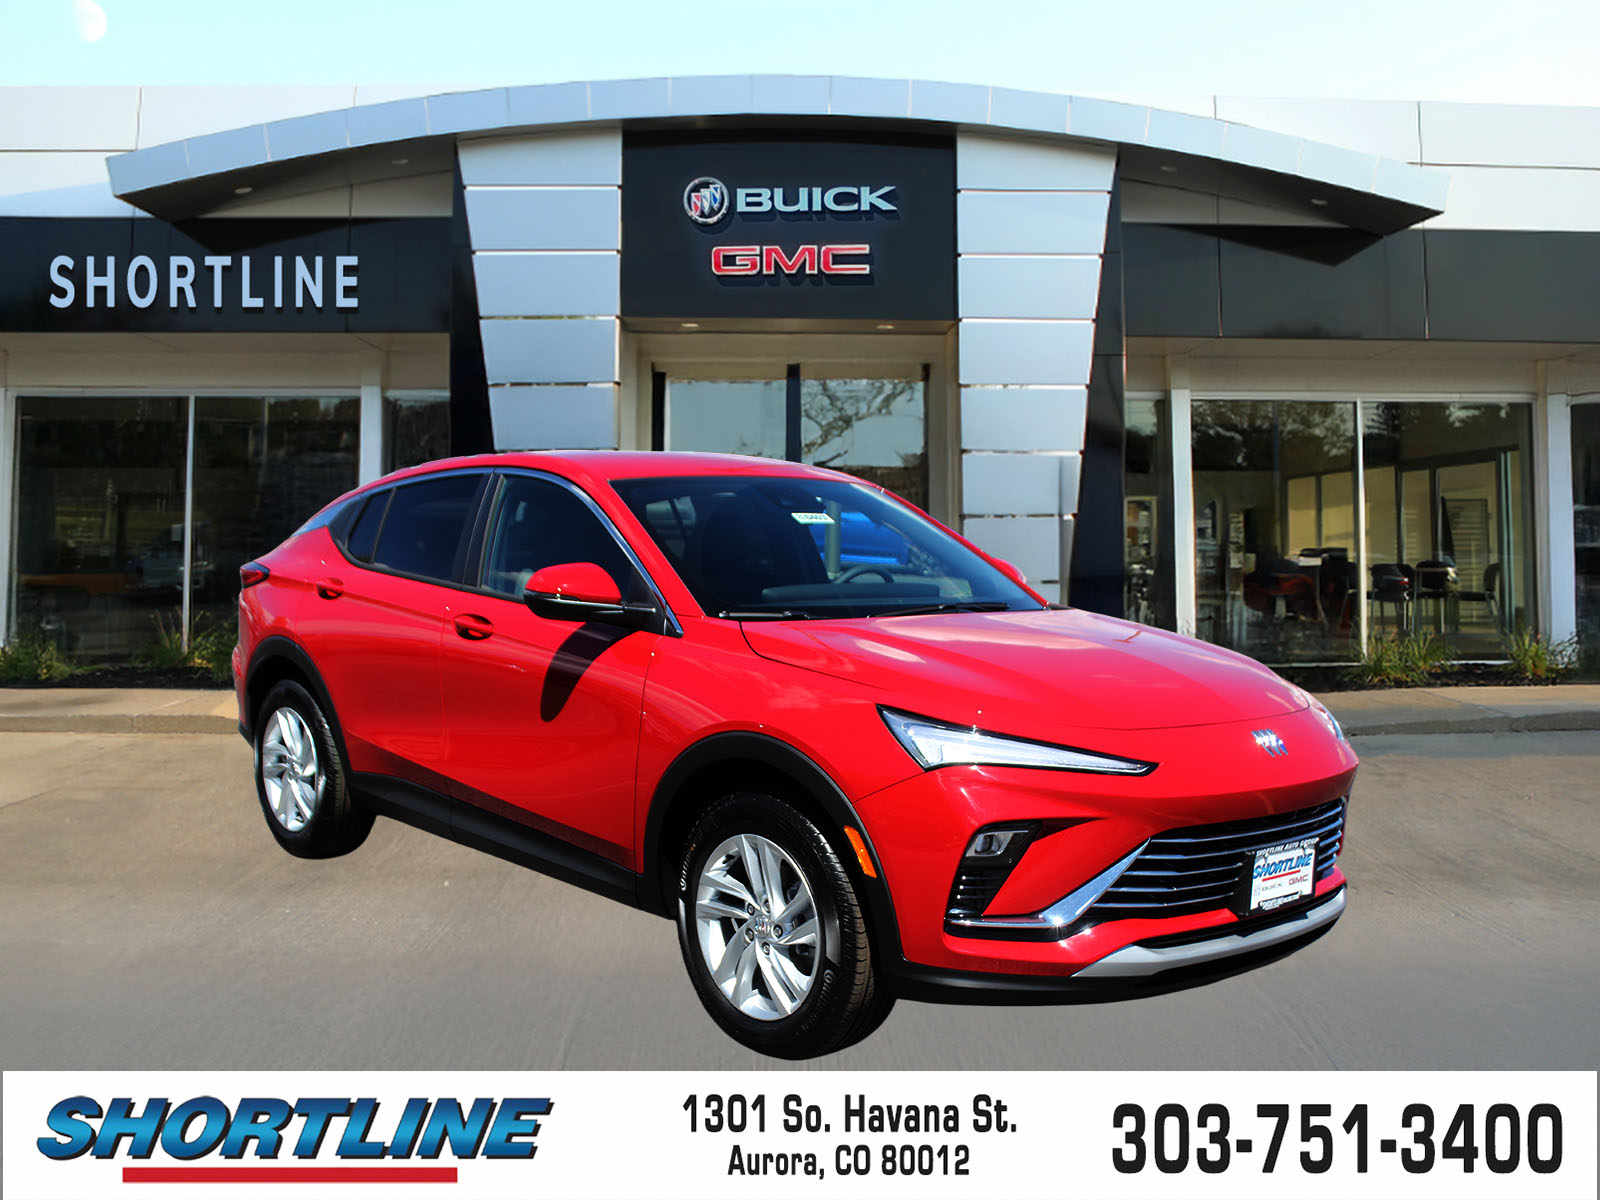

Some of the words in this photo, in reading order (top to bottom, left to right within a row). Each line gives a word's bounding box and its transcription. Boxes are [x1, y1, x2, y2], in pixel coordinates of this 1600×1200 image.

[736, 186, 897, 212] BUICK
[711, 244, 870, 275] GMC
[49, 255, 358, 308] SHORTLINE
[1253, 853, 1313, 880] SHORTLINE
[1288, 874, 1309, 886] GMC
